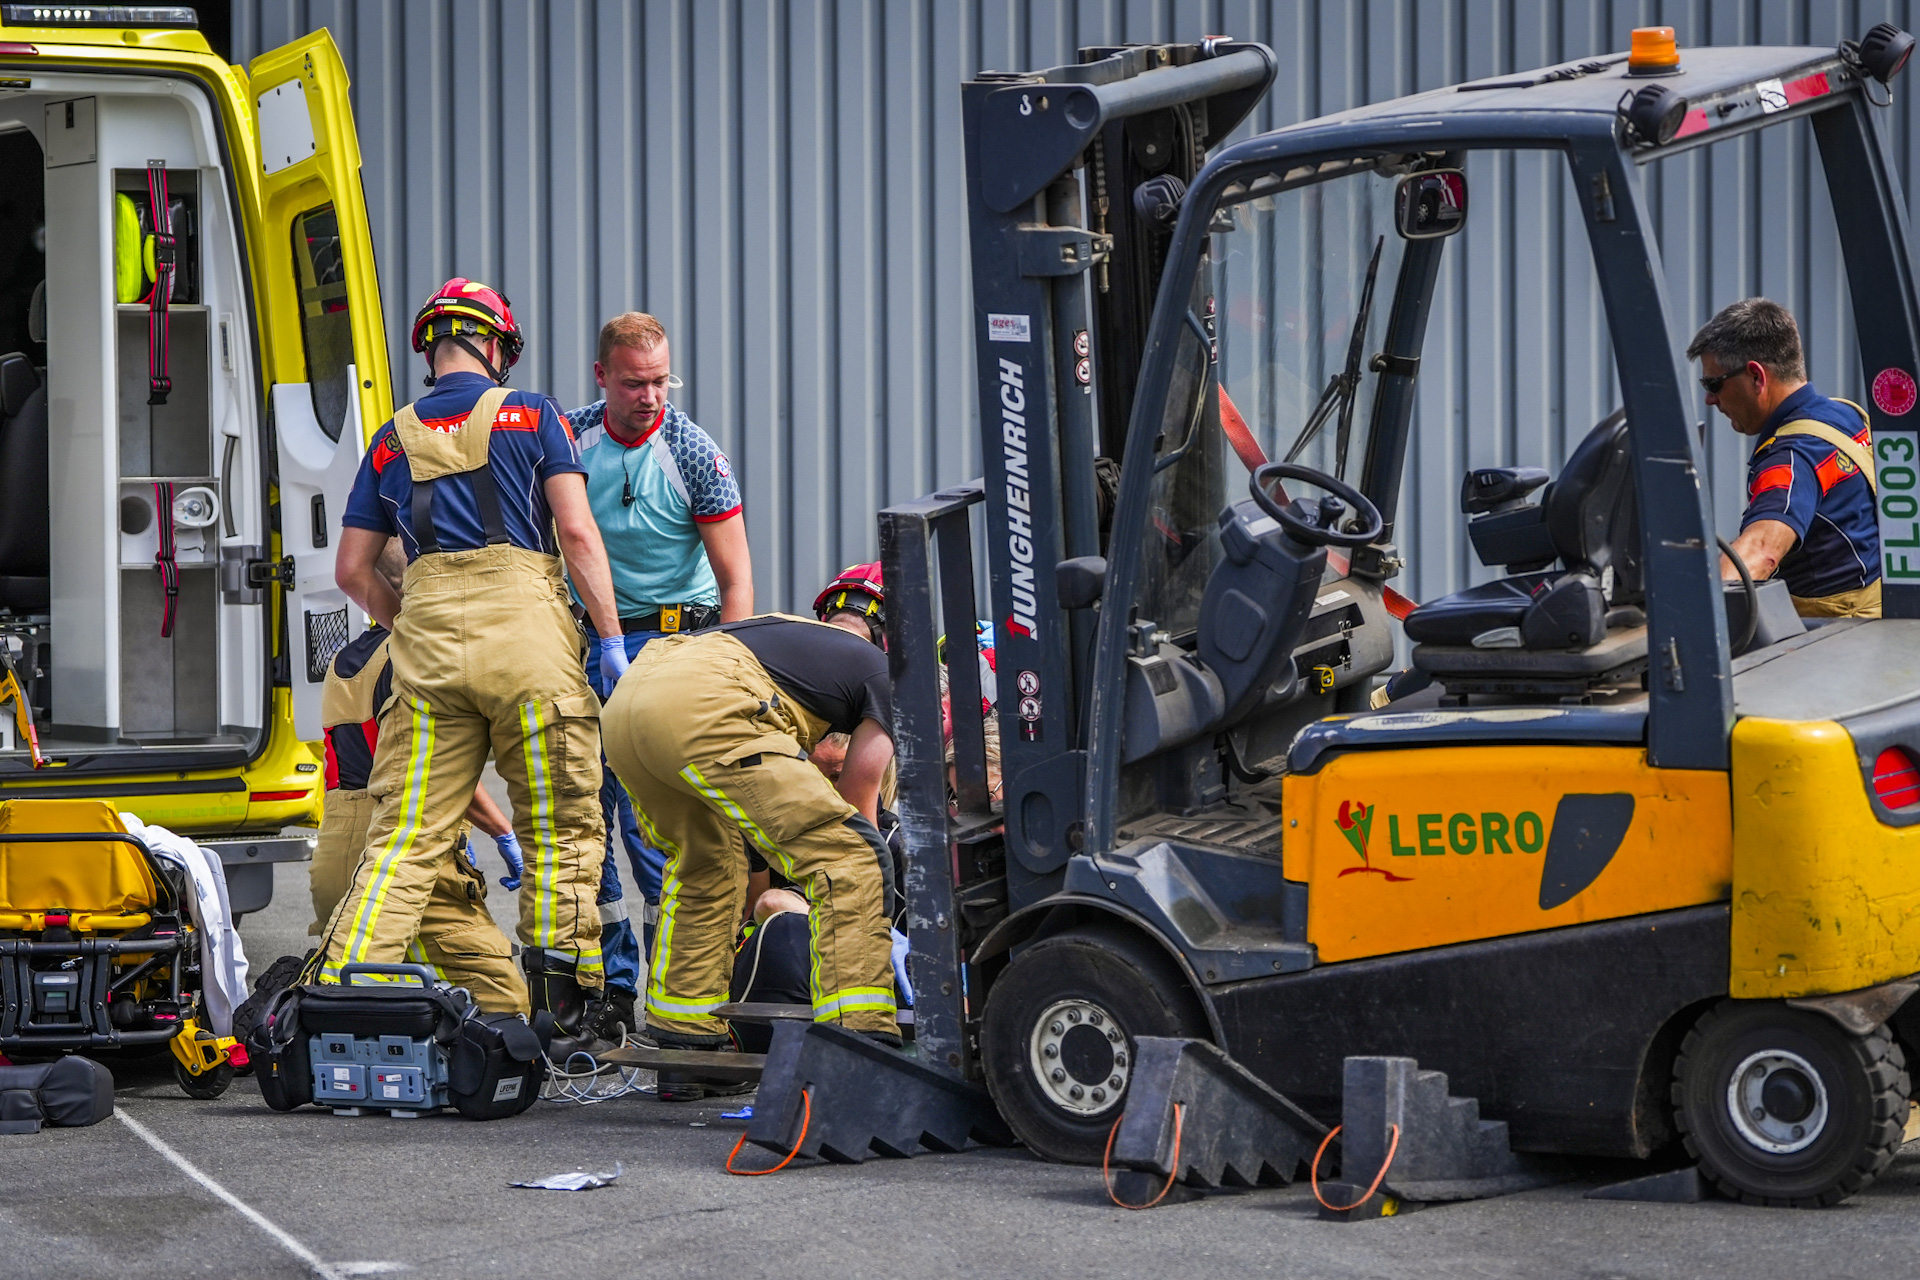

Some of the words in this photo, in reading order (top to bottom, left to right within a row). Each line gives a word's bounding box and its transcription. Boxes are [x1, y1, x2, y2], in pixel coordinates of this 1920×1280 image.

[999, 357, 1038, 641] JUNGHEINRICH
[1877, 437, 1920, 579] FL003
[1388, 811, 1544, 857] LEGRO
